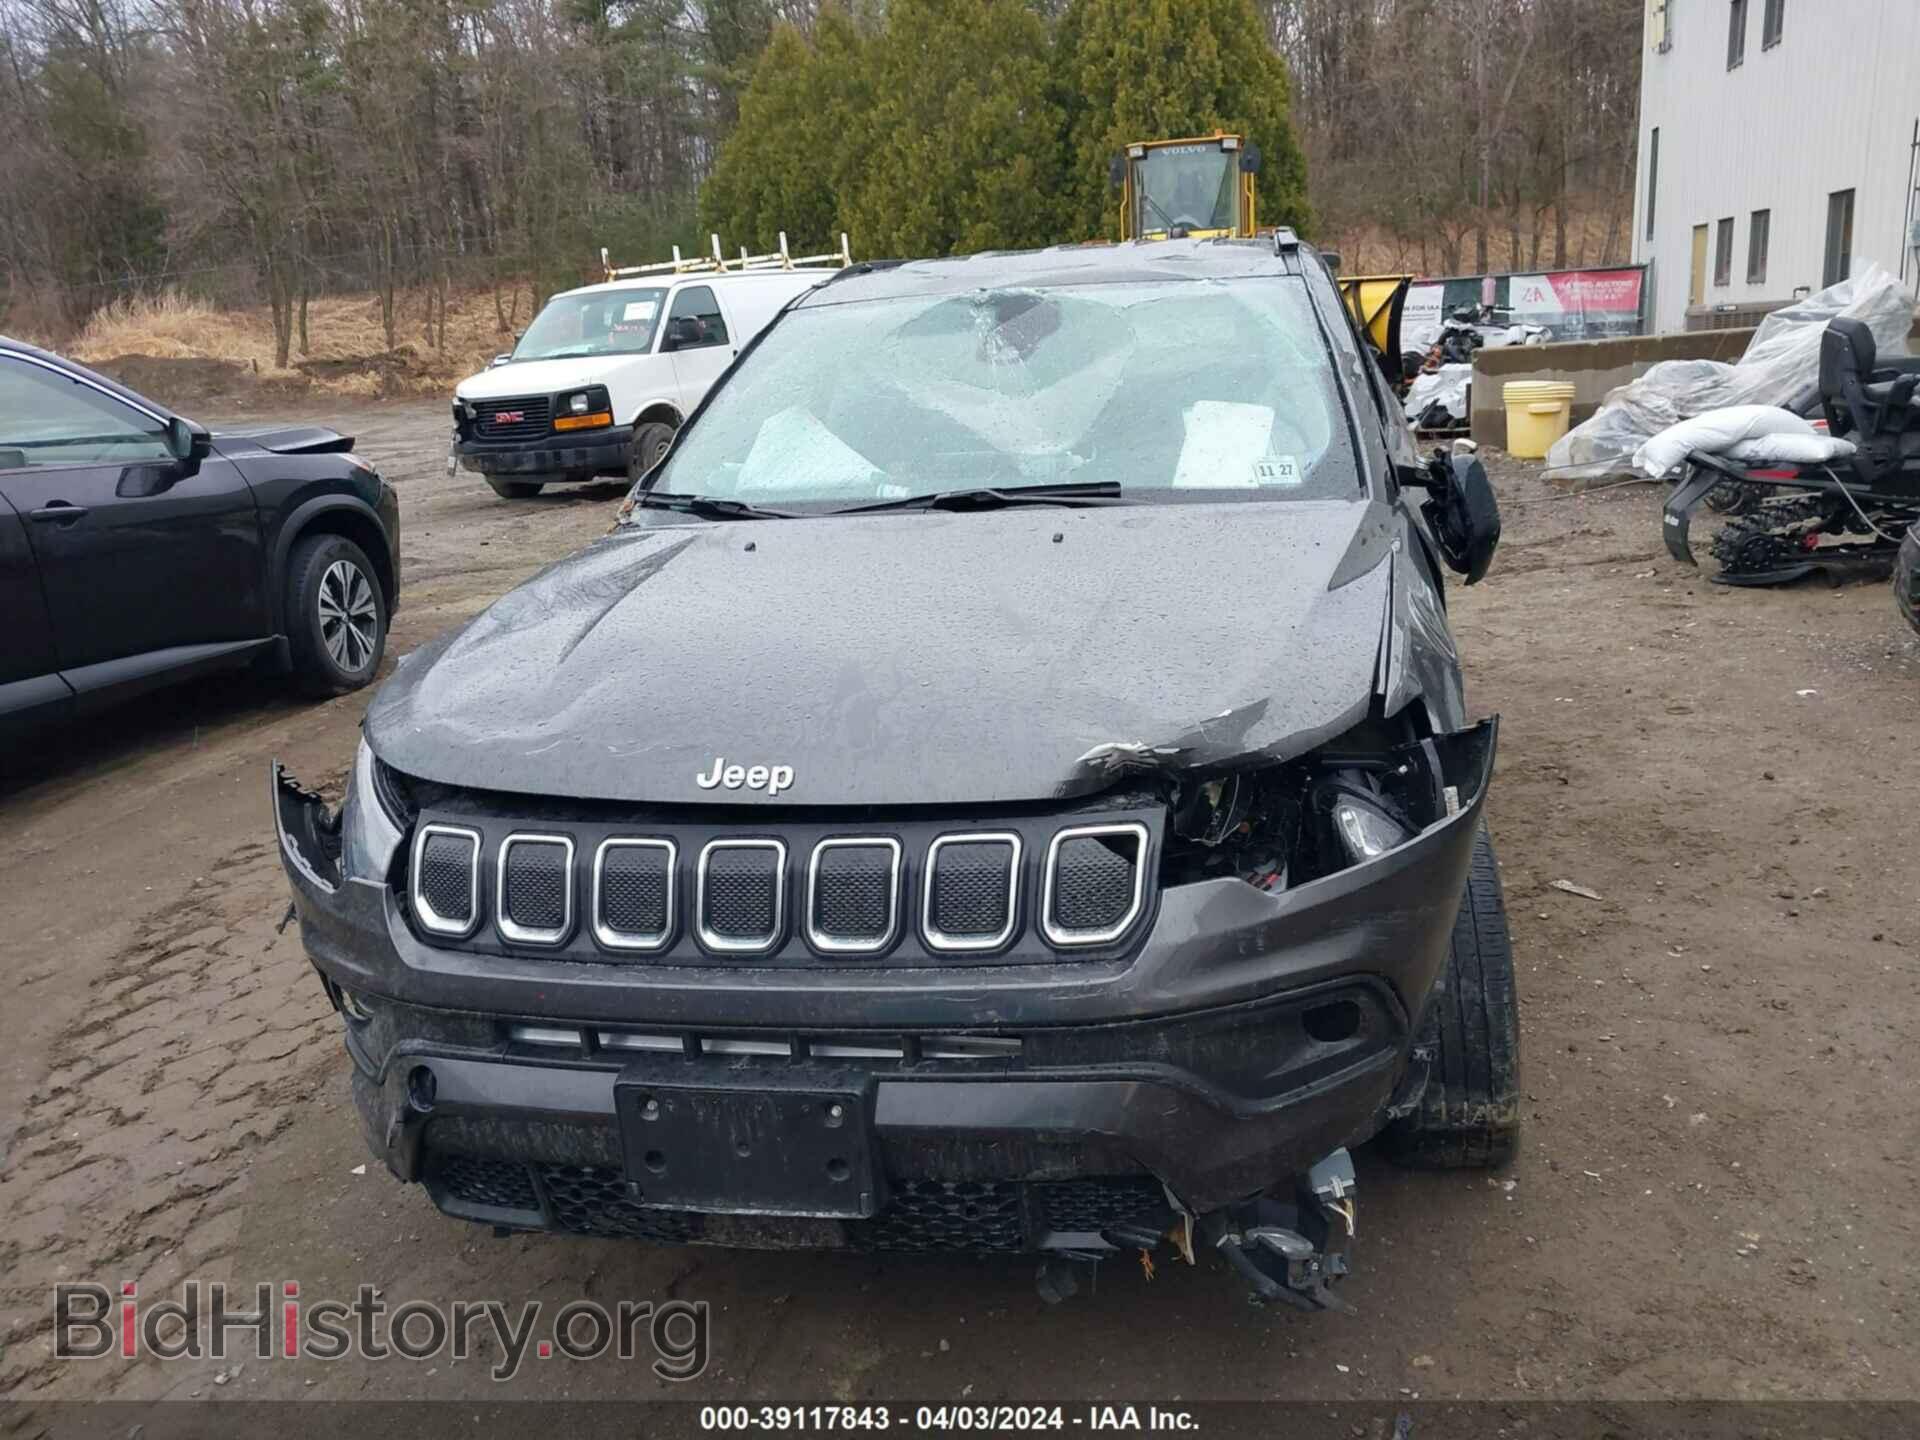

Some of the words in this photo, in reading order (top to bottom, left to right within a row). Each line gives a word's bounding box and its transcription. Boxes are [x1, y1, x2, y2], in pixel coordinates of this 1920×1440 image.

[1160, 144, 1206, 156] VOLVO
[495, 410, 525, 424] GMC
[1259, 464, 1275, 477] 11
[1279, 463, 1292, 476] 27
[696, 757, 795, 797] Jeep
